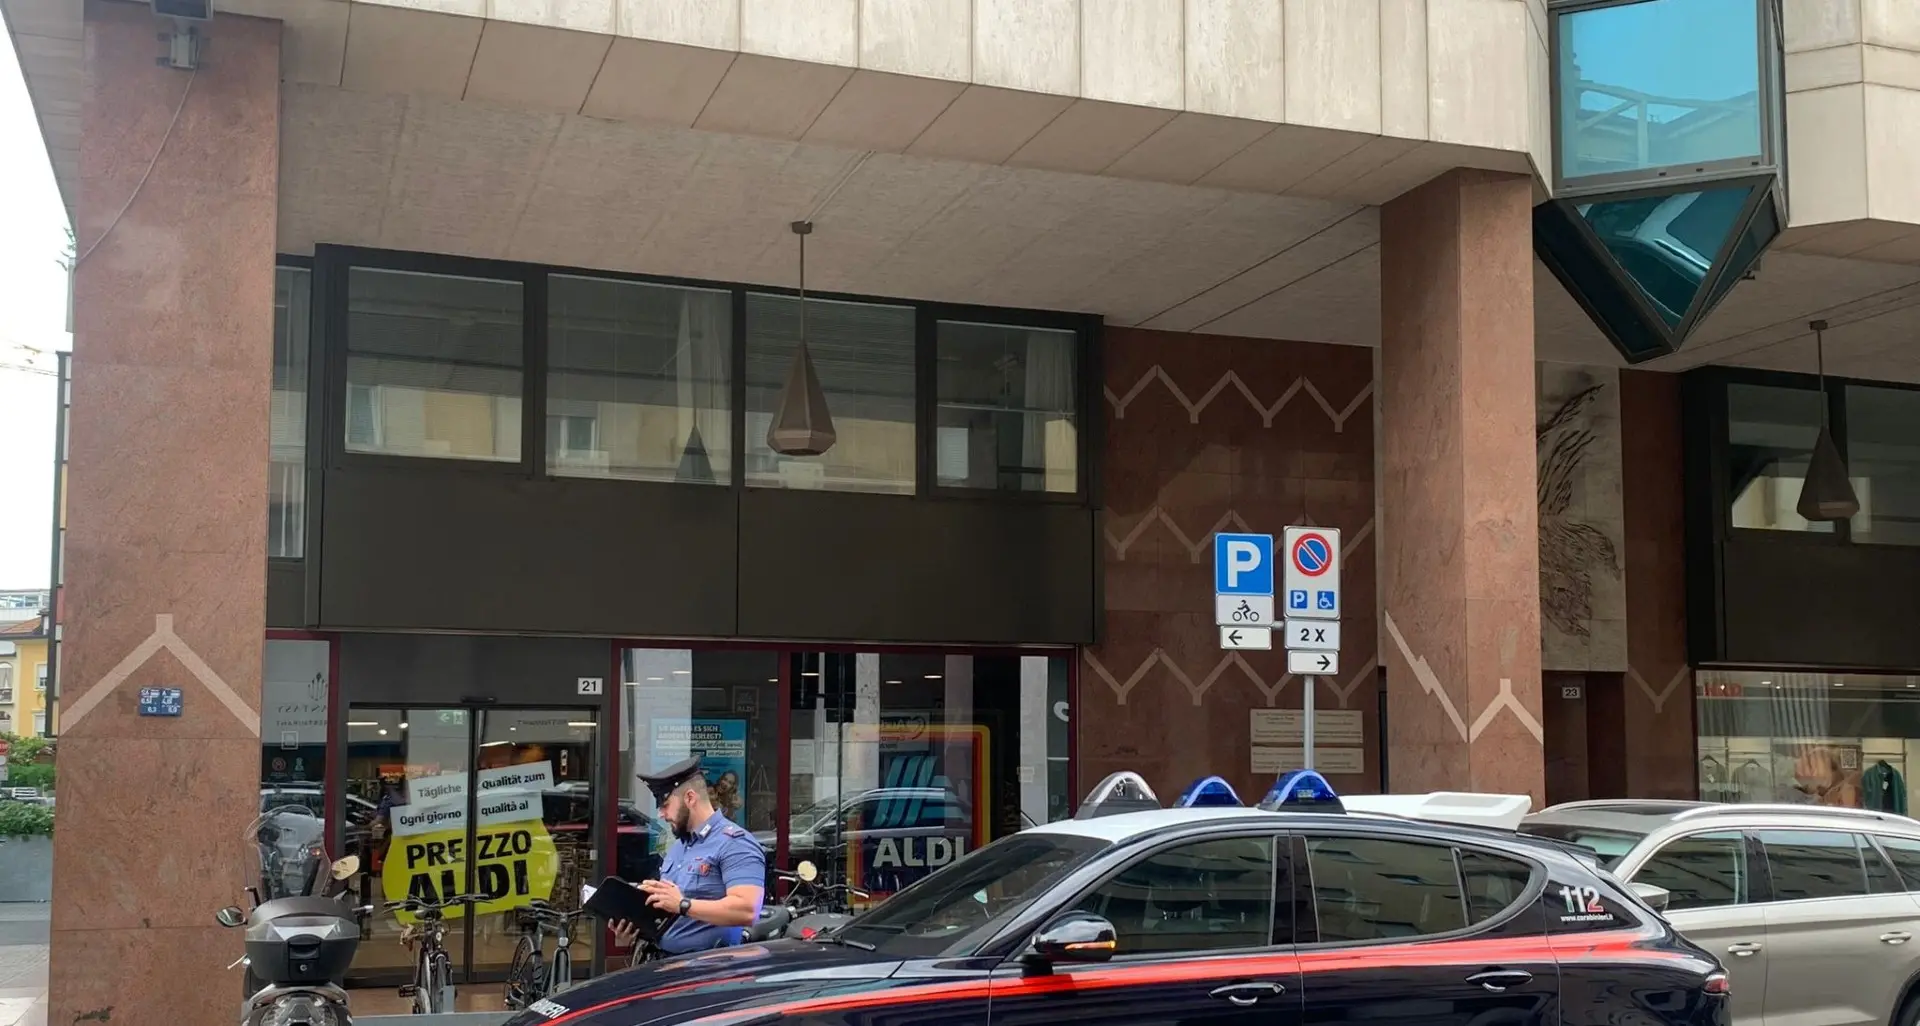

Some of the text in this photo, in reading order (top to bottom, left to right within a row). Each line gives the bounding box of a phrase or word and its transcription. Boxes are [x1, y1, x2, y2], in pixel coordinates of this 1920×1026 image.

[1227, 541, 1261, 587] P
[1293, 591, 1305, 607] P
[1301, 628, 1325, 642] 2 X
[582, 680, 597, 692] 21
[1565, 688, 1578, 697] 23
[482, 772, 545, 790] Qualität zum
[418, 784, 462, 799] Tägliche
[481, 800, 529, 816] qualità al
[400, 810, 462, 826] Ogni giorno
[872, 836, 965, 867] ALDI
[405, 859, 530, 911] ALDI
[1559, 885, 1604, 913] 112
